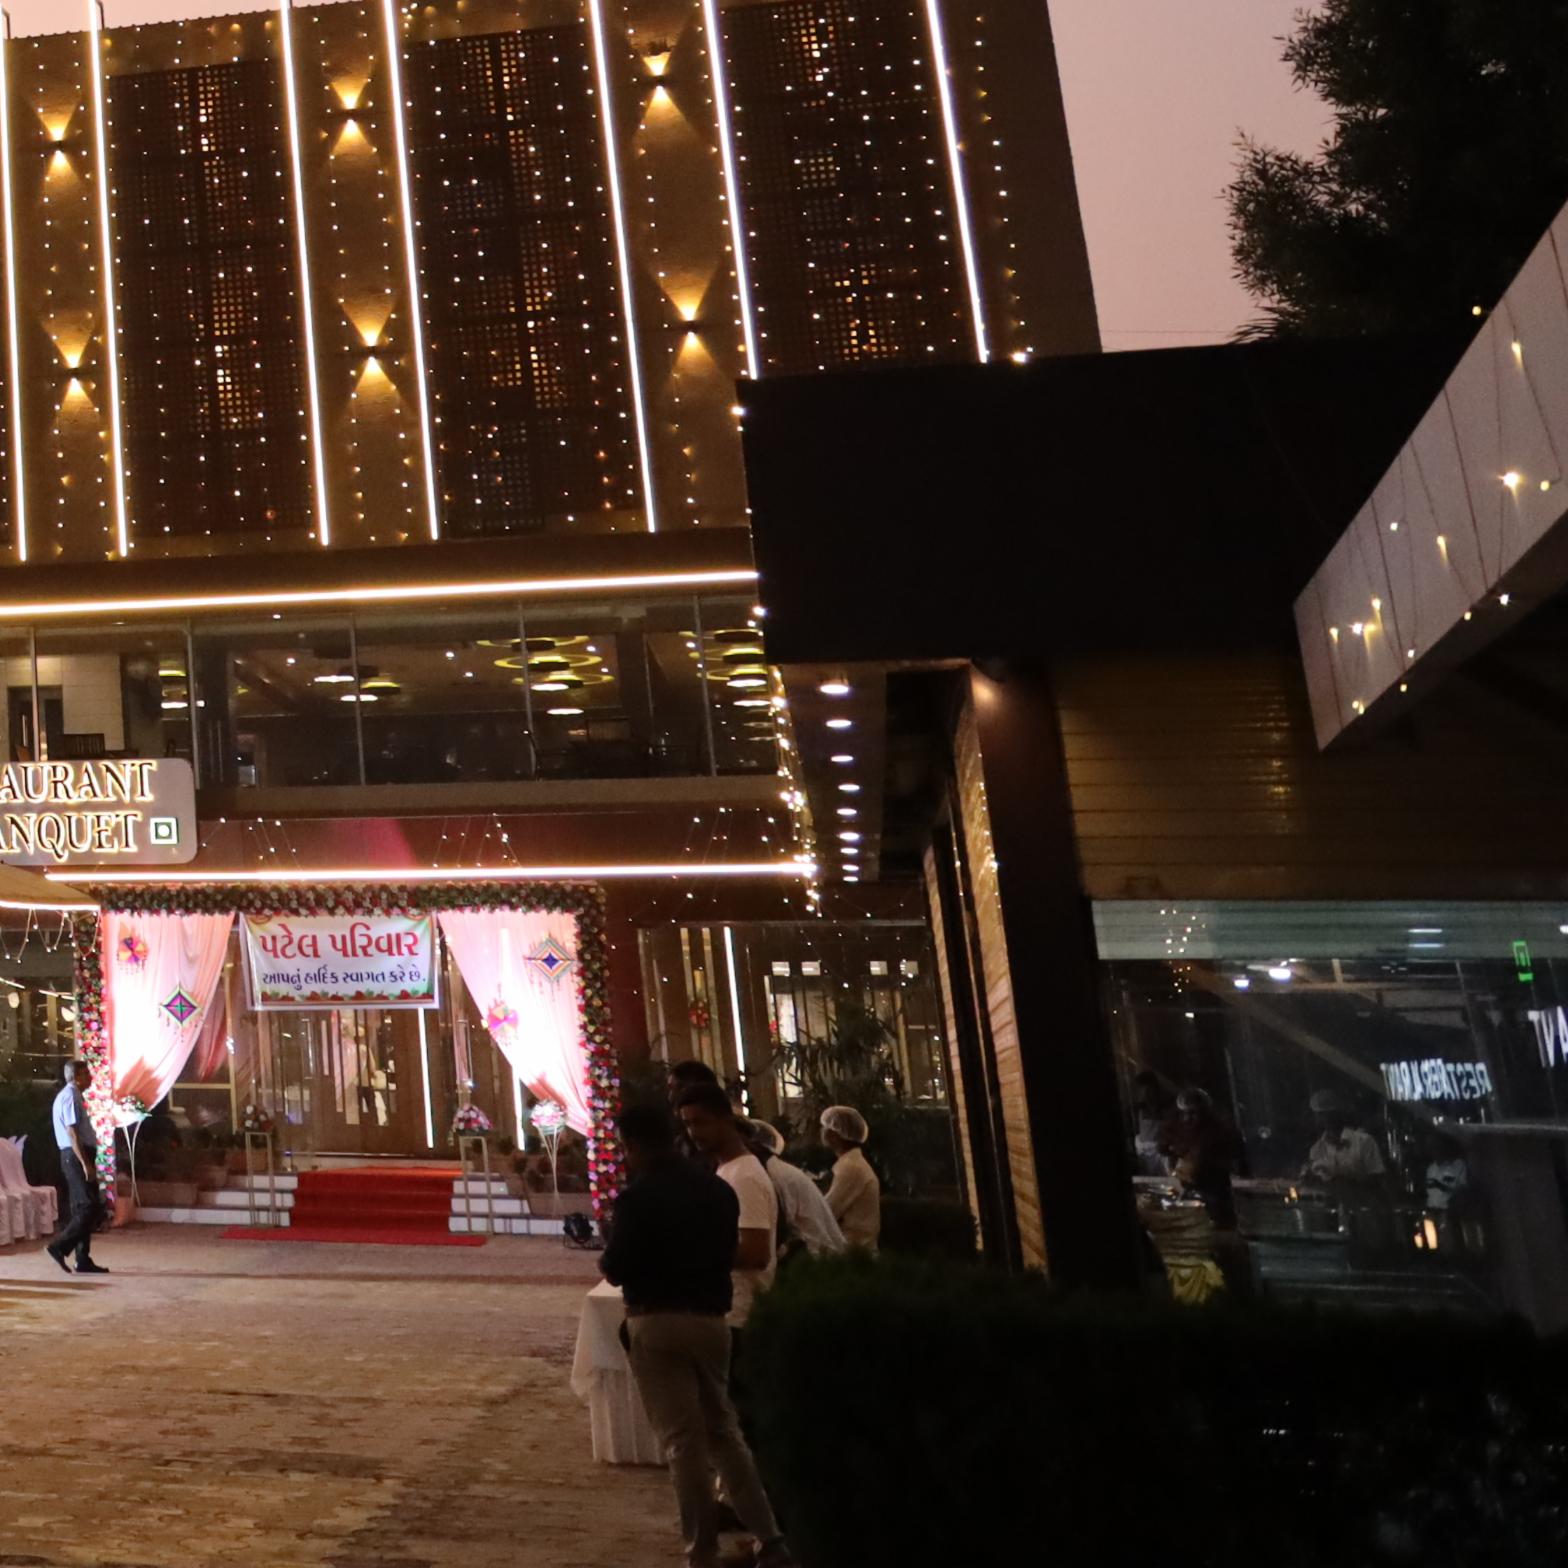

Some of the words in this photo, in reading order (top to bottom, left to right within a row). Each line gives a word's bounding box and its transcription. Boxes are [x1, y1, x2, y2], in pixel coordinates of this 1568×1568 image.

[259, 923, 321, 959] પટેલ
[328, 922, 420, 958] પરિવાર
[262, 968, 302, 991] આપનું
[342, 970, 385, 984] સ્વાગત
[389, 964, 405, 984] કરે
